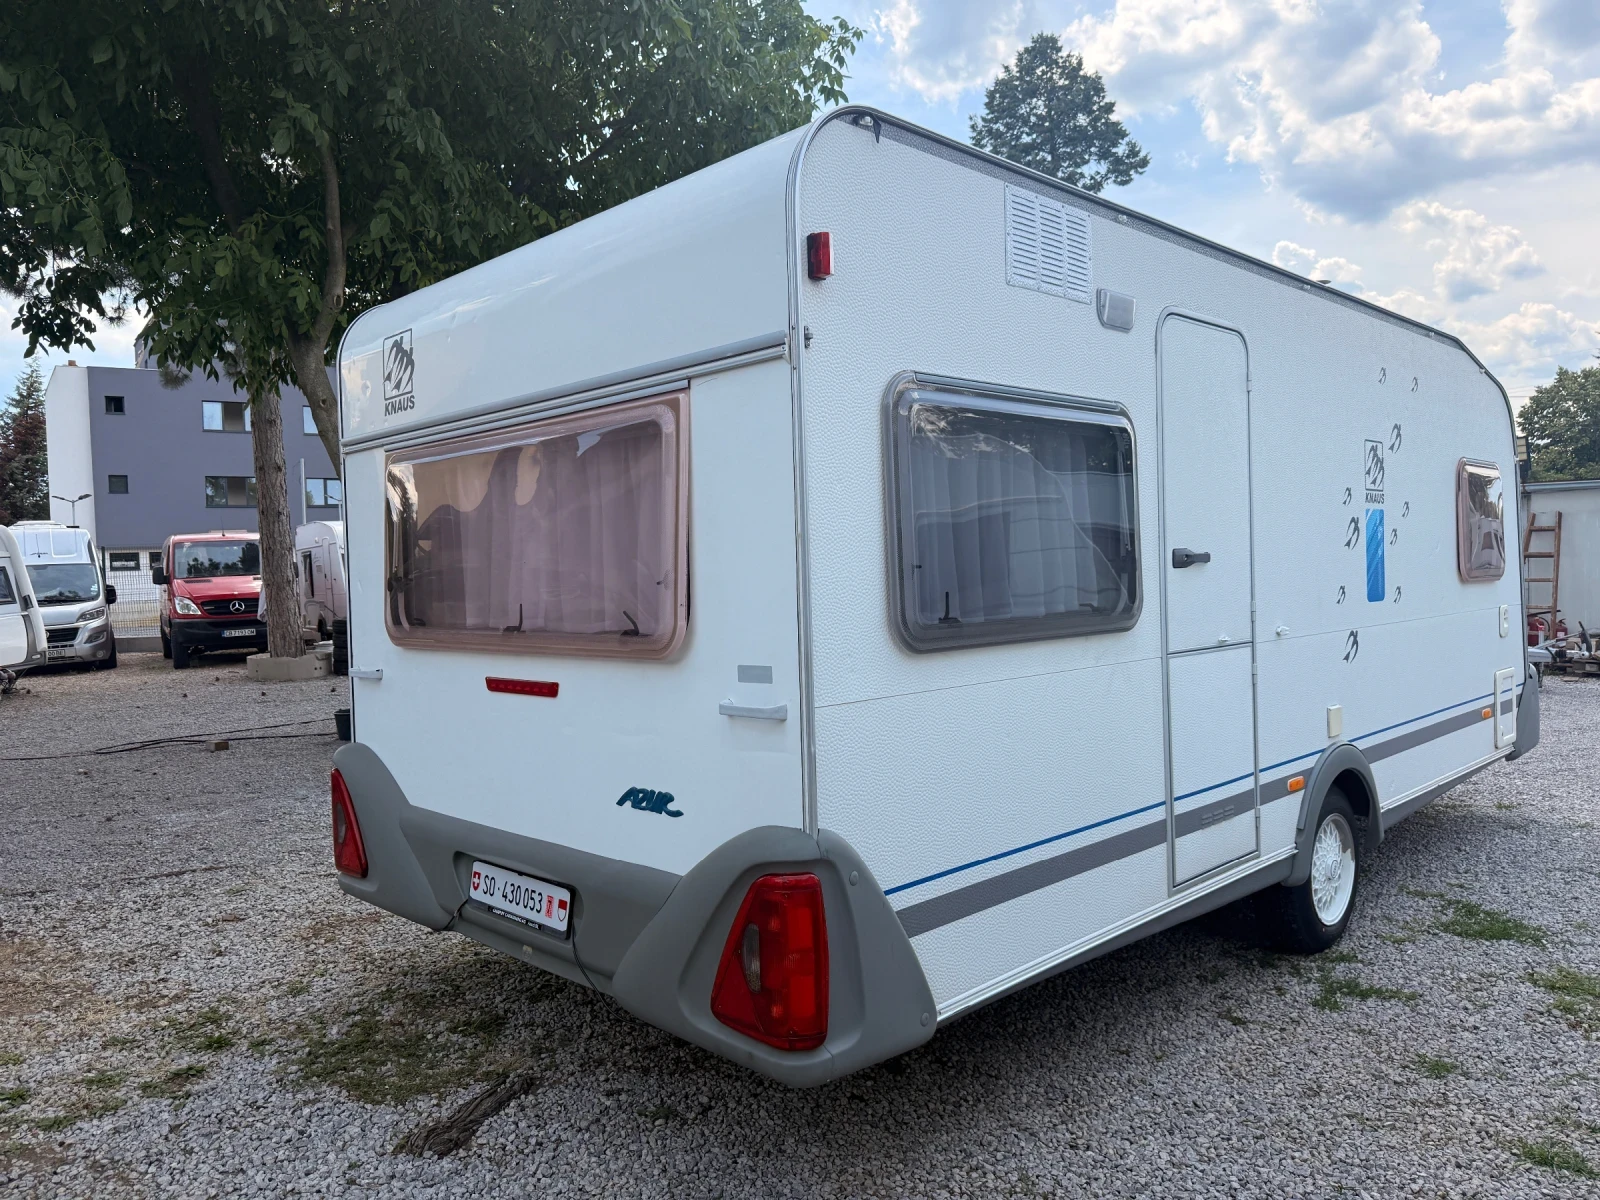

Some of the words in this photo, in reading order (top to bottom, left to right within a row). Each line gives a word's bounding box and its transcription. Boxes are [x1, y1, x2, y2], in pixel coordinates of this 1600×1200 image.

[384, 394, 415, 417] KNAUS
[1365, 492, 1385, 504] KNAUS
[615, 786, 684, 818] AZUR
